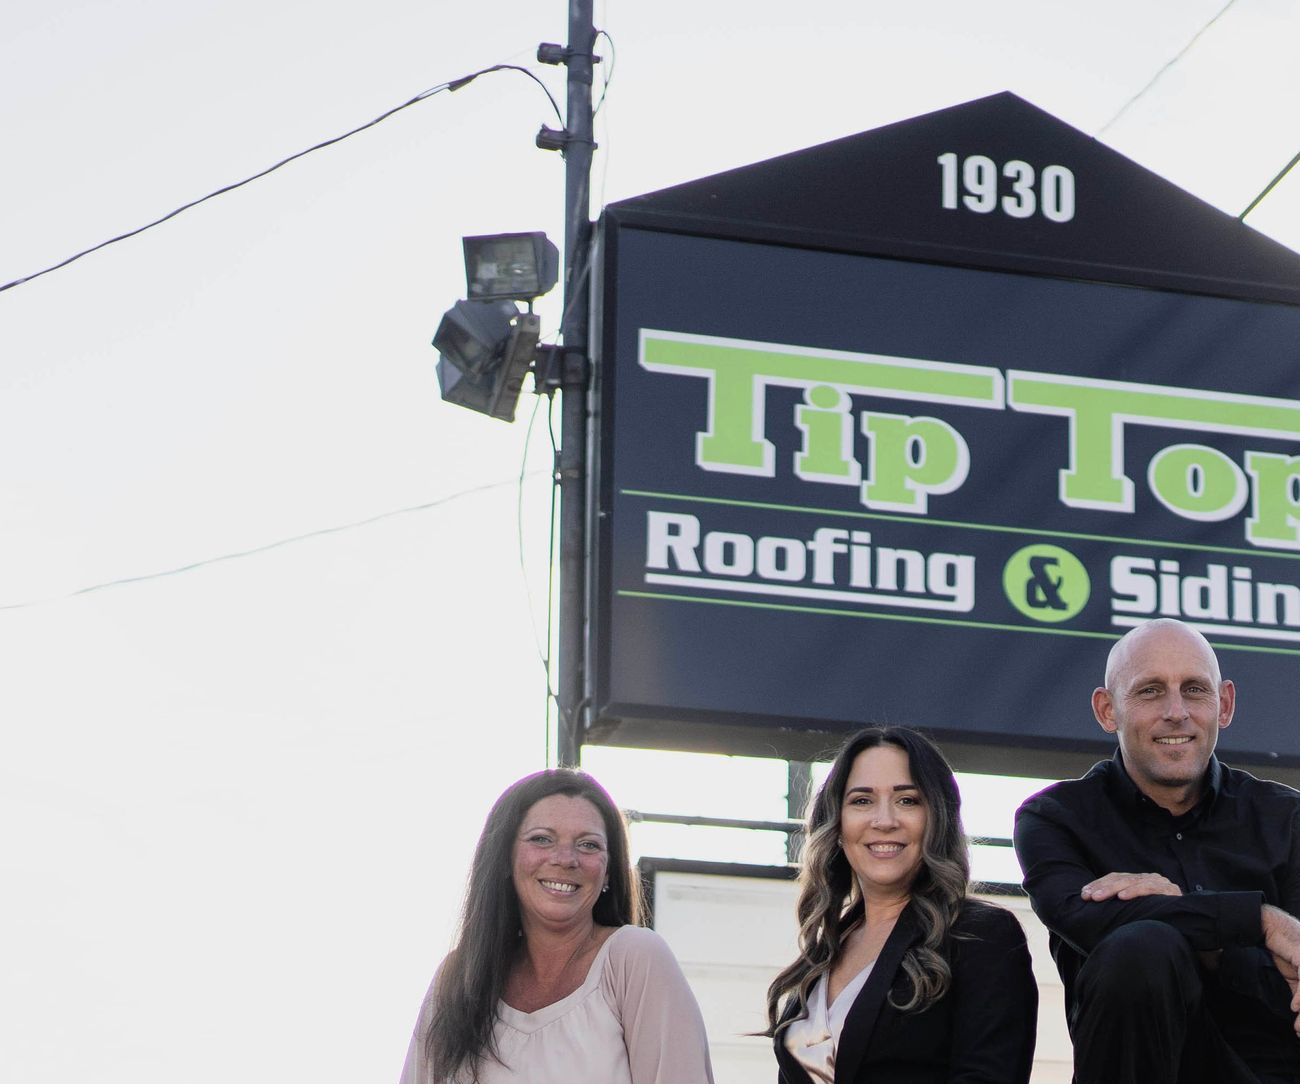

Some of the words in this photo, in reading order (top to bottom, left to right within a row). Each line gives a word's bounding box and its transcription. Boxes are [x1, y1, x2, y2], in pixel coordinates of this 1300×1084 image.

[937, 152, 1075, 222] 1930
[638, 327, 1006, 515] Tip
[645, 510, 976, 613] Roofing
[1026, 555, 1069, 612] &
